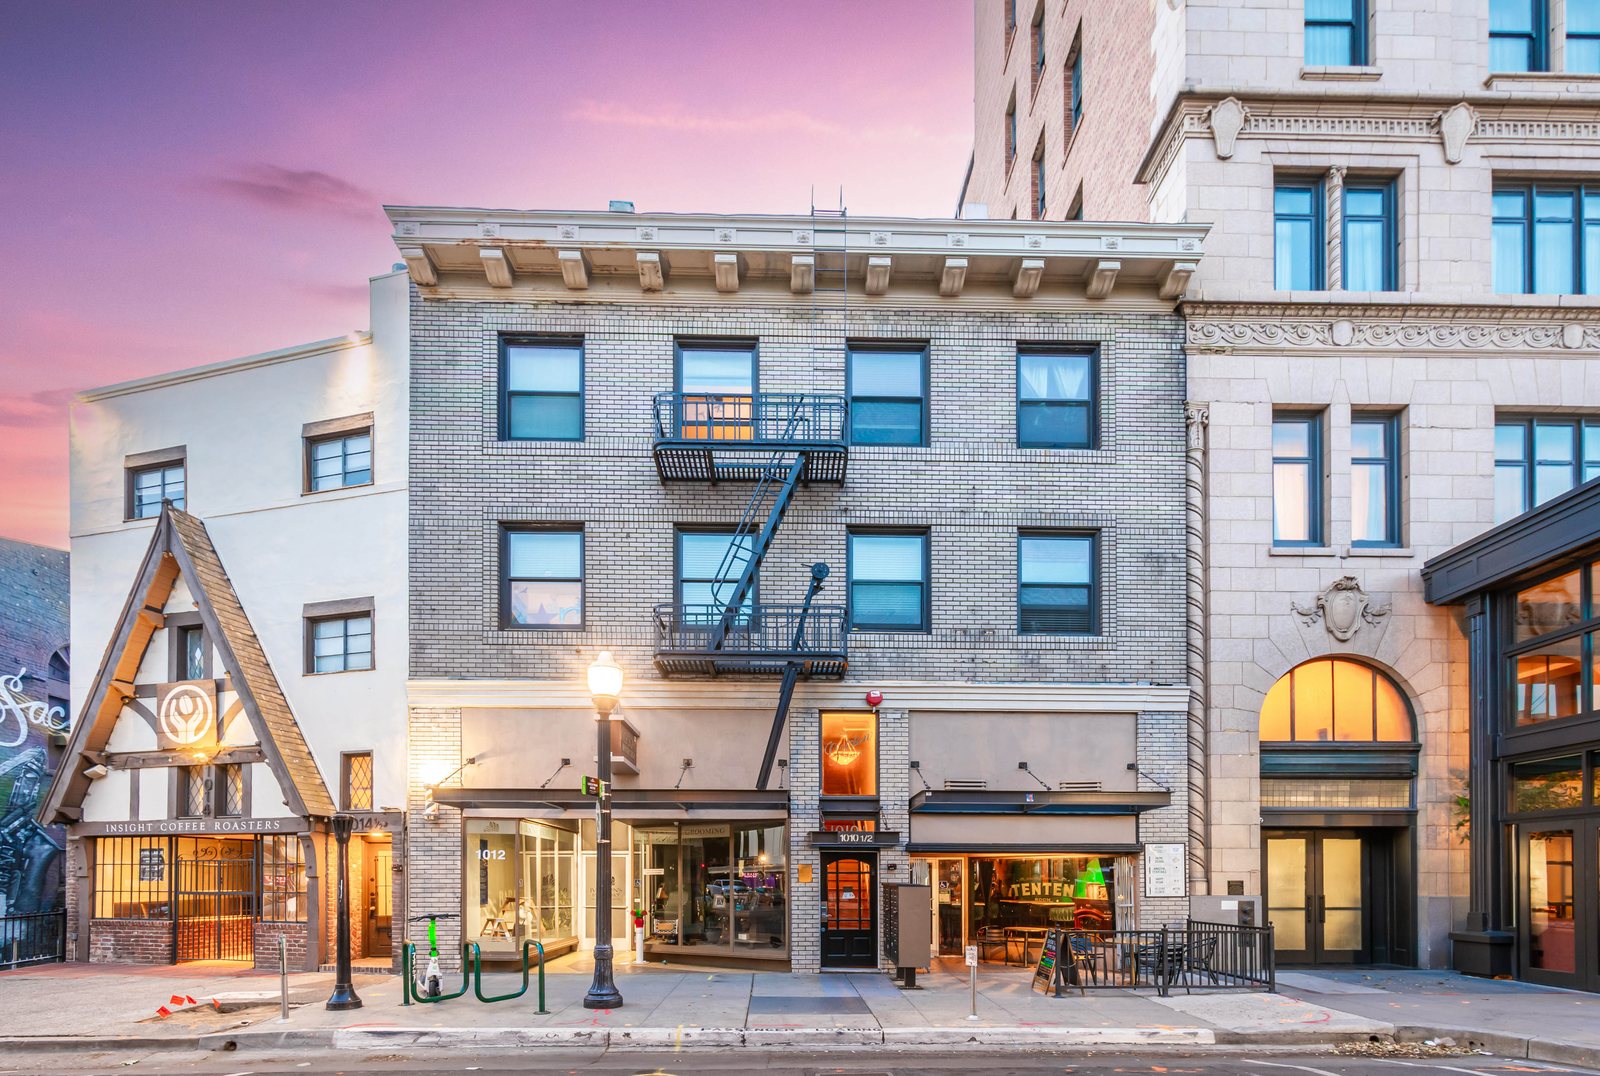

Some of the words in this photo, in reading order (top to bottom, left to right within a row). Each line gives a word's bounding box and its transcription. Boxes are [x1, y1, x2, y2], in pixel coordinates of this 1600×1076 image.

[106, 823, 153, 833] INSIGHT
[160, 821, 206, 832] COFFEE
[214, 820, 281, 831] ROASTERS
[840, 834, 859, 842] 1010
[860, 834, 873, 843] 1/2
[475, 849, 506, 860] 1012
[1008, 882, 1075, 897] TENTEN
